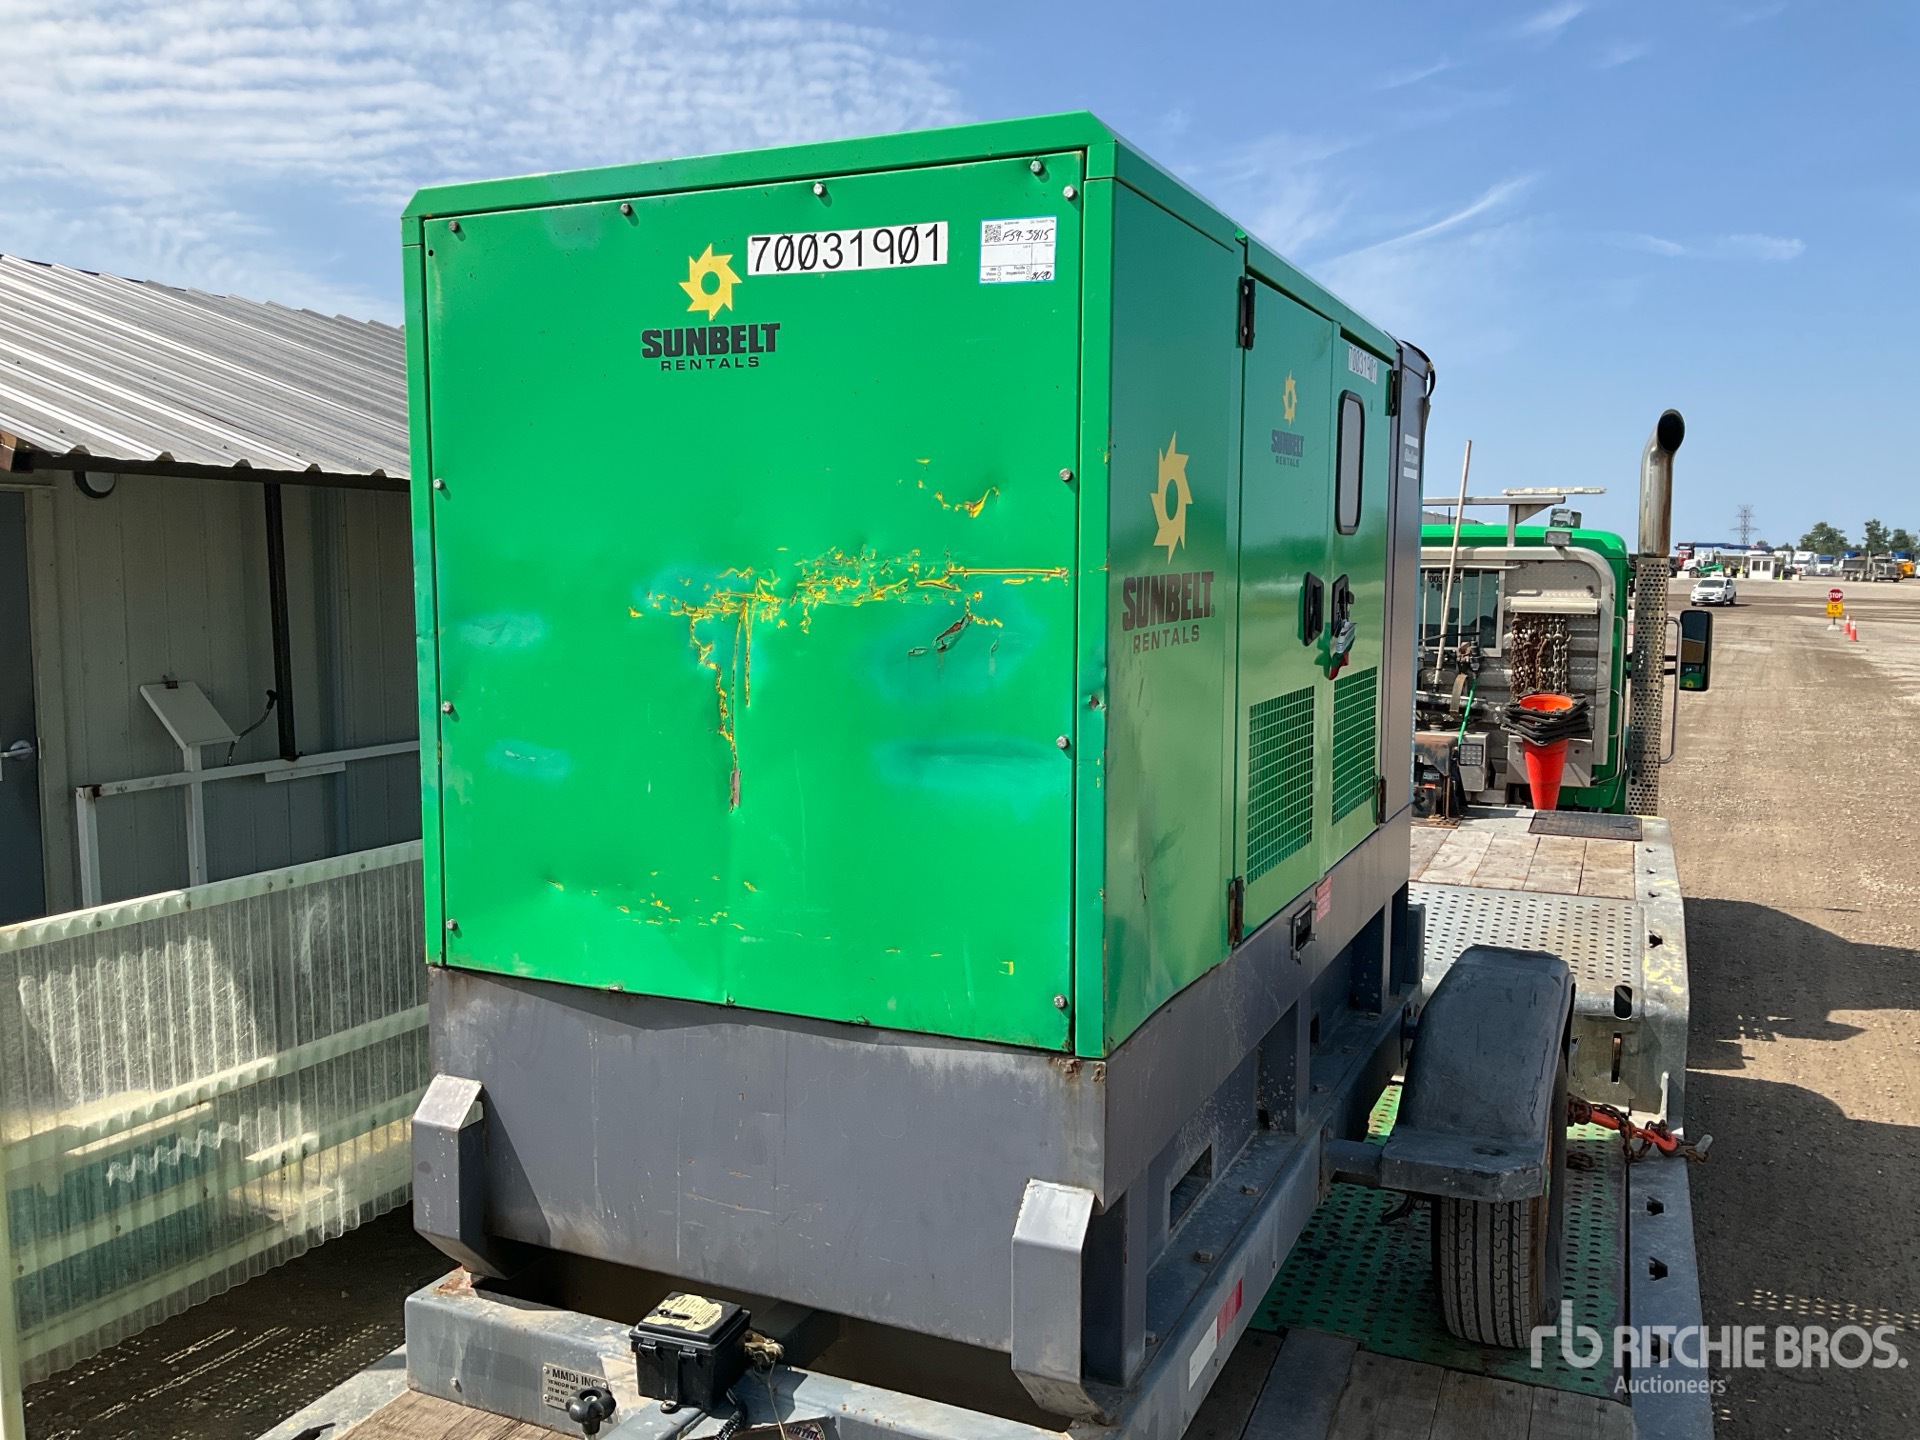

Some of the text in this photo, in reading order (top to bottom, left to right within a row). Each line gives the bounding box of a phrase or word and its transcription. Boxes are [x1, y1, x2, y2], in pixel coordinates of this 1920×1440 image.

[751, 223, 939, 272] 70031901
[641, 323, 780, 359] SUNBELT
[660, 356, 760, 371] RENTALS
[1122, 571, 1214, 632] SUNBELT
[1133, 624, 1200, 654] RENTALS
